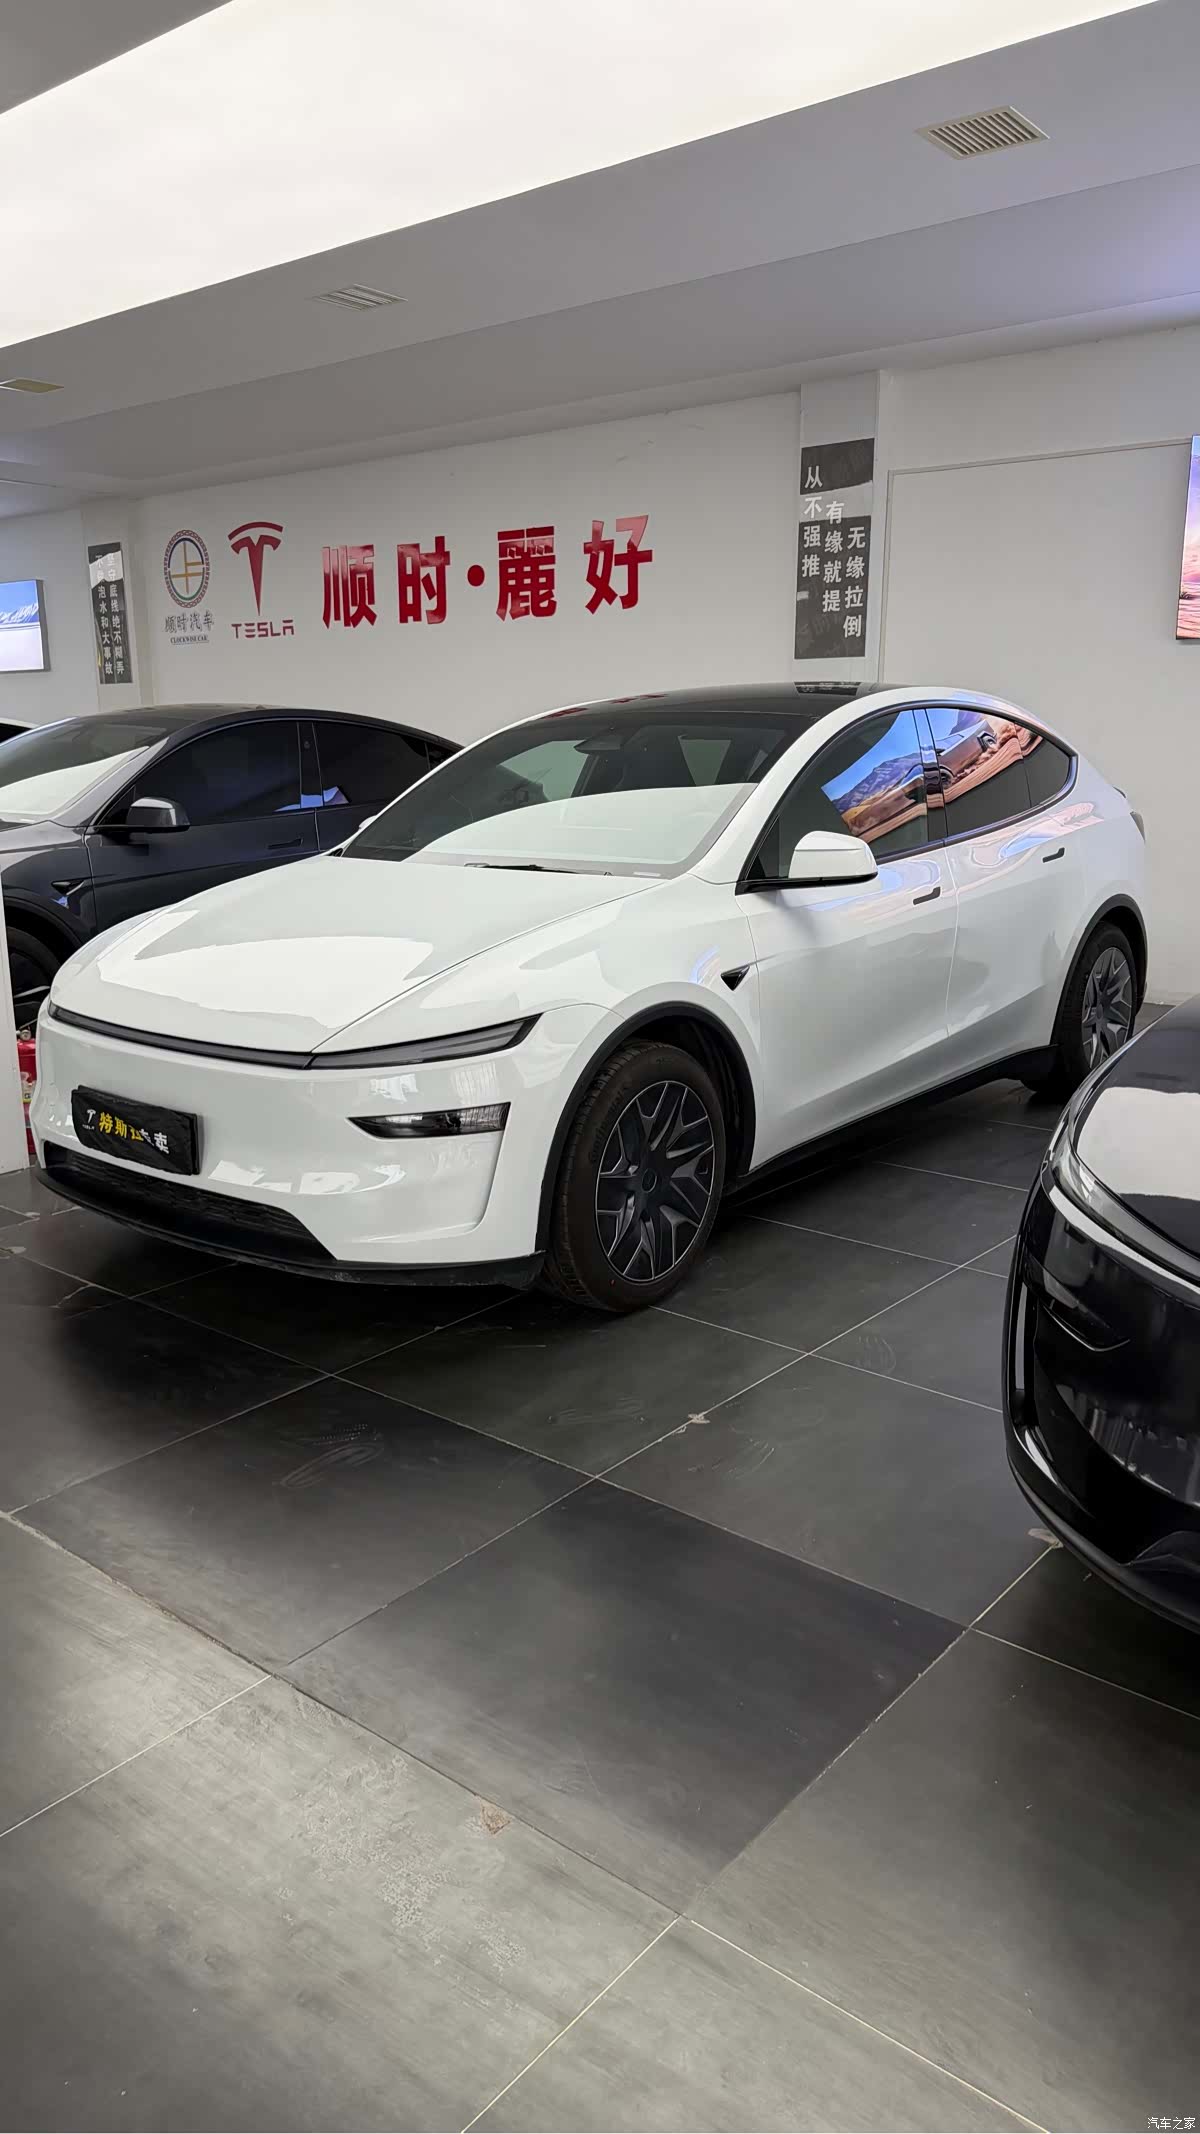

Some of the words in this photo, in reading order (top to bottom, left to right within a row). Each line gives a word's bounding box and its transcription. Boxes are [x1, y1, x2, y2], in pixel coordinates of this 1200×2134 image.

[802, 465, 823, 578] 从不强推
[822, 501, 844, 613] 有缘就提
[164, 610, 214, 633] 顺时汽车
[231, 619, 295, 639] TESLA
[843, 526, 865, 638] 无缘拉倒
